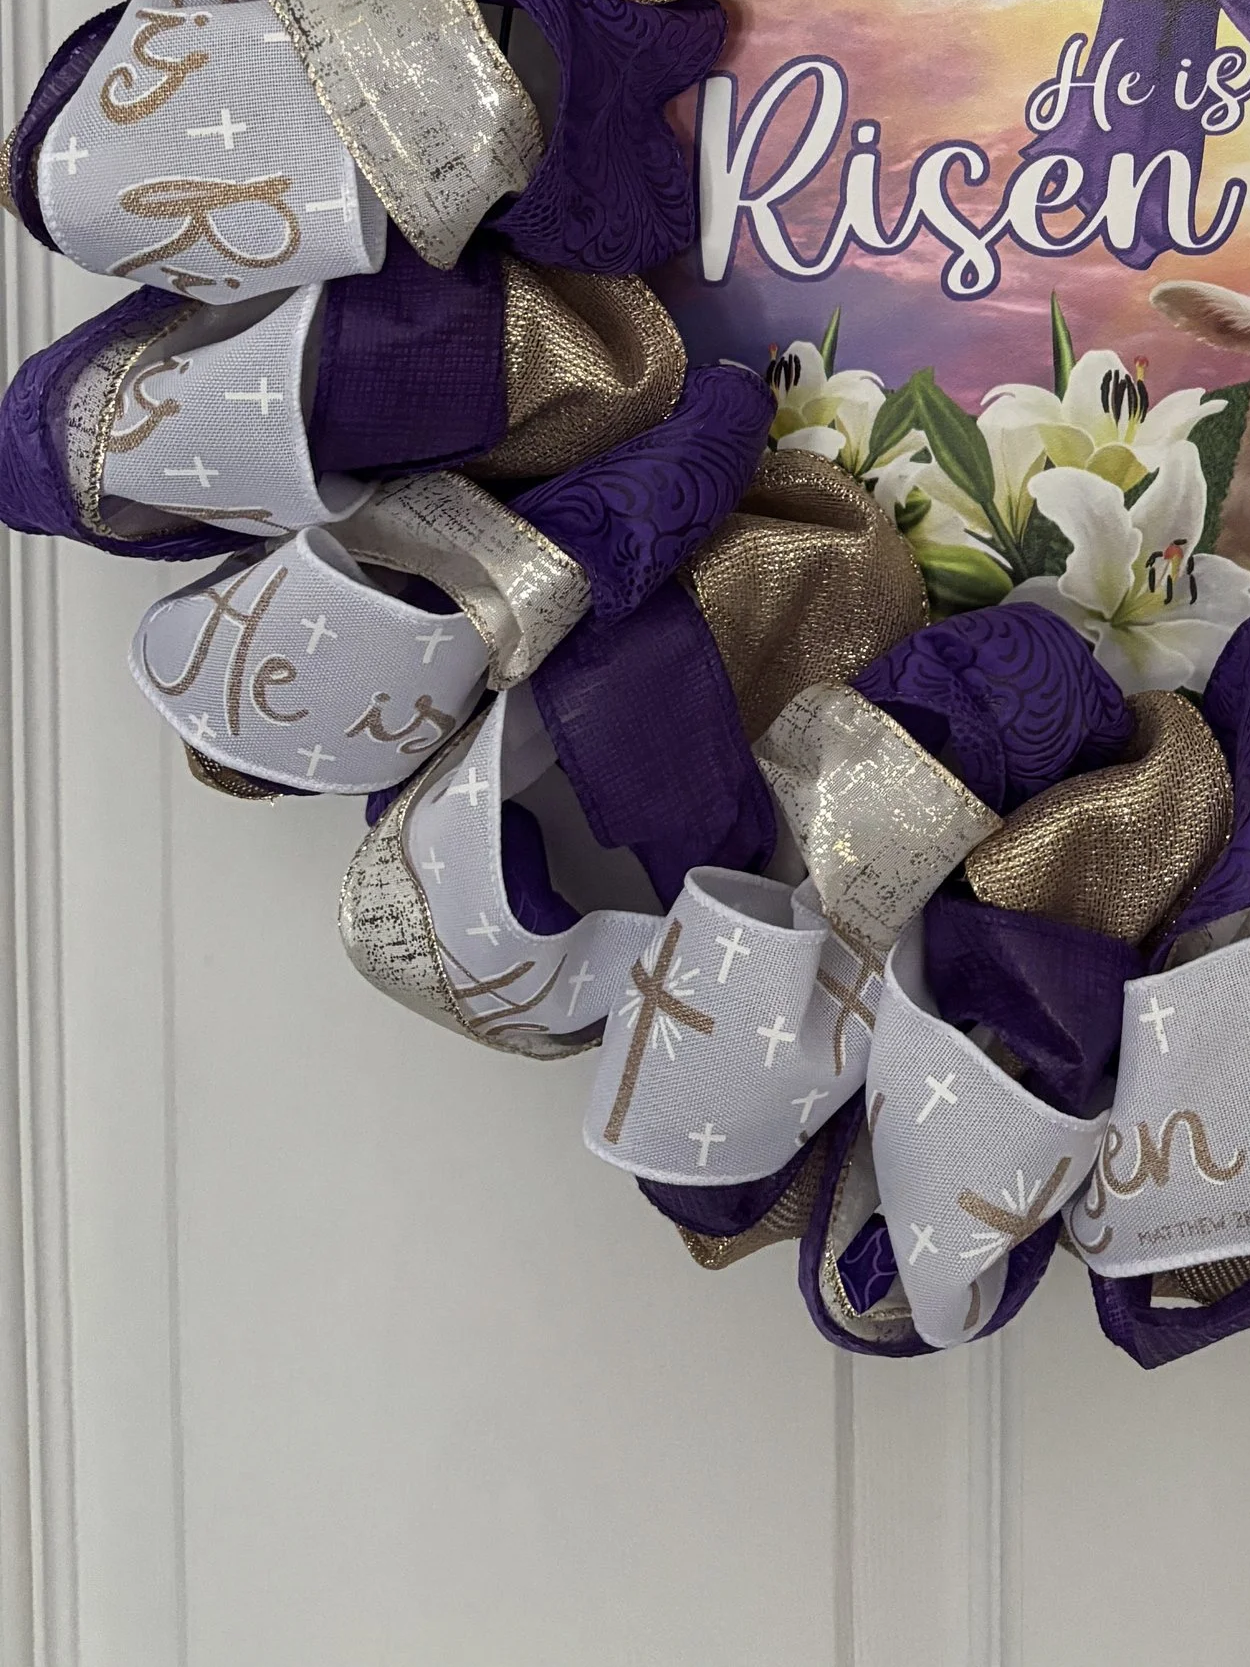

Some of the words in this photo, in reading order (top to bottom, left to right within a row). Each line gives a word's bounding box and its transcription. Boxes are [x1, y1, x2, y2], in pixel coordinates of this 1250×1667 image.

[699, 54, 1248, 301] Risen
[1025, 32, 1157, 134] He
[141, 564, 309, 737] He
[343, 691, 457, 756] is
